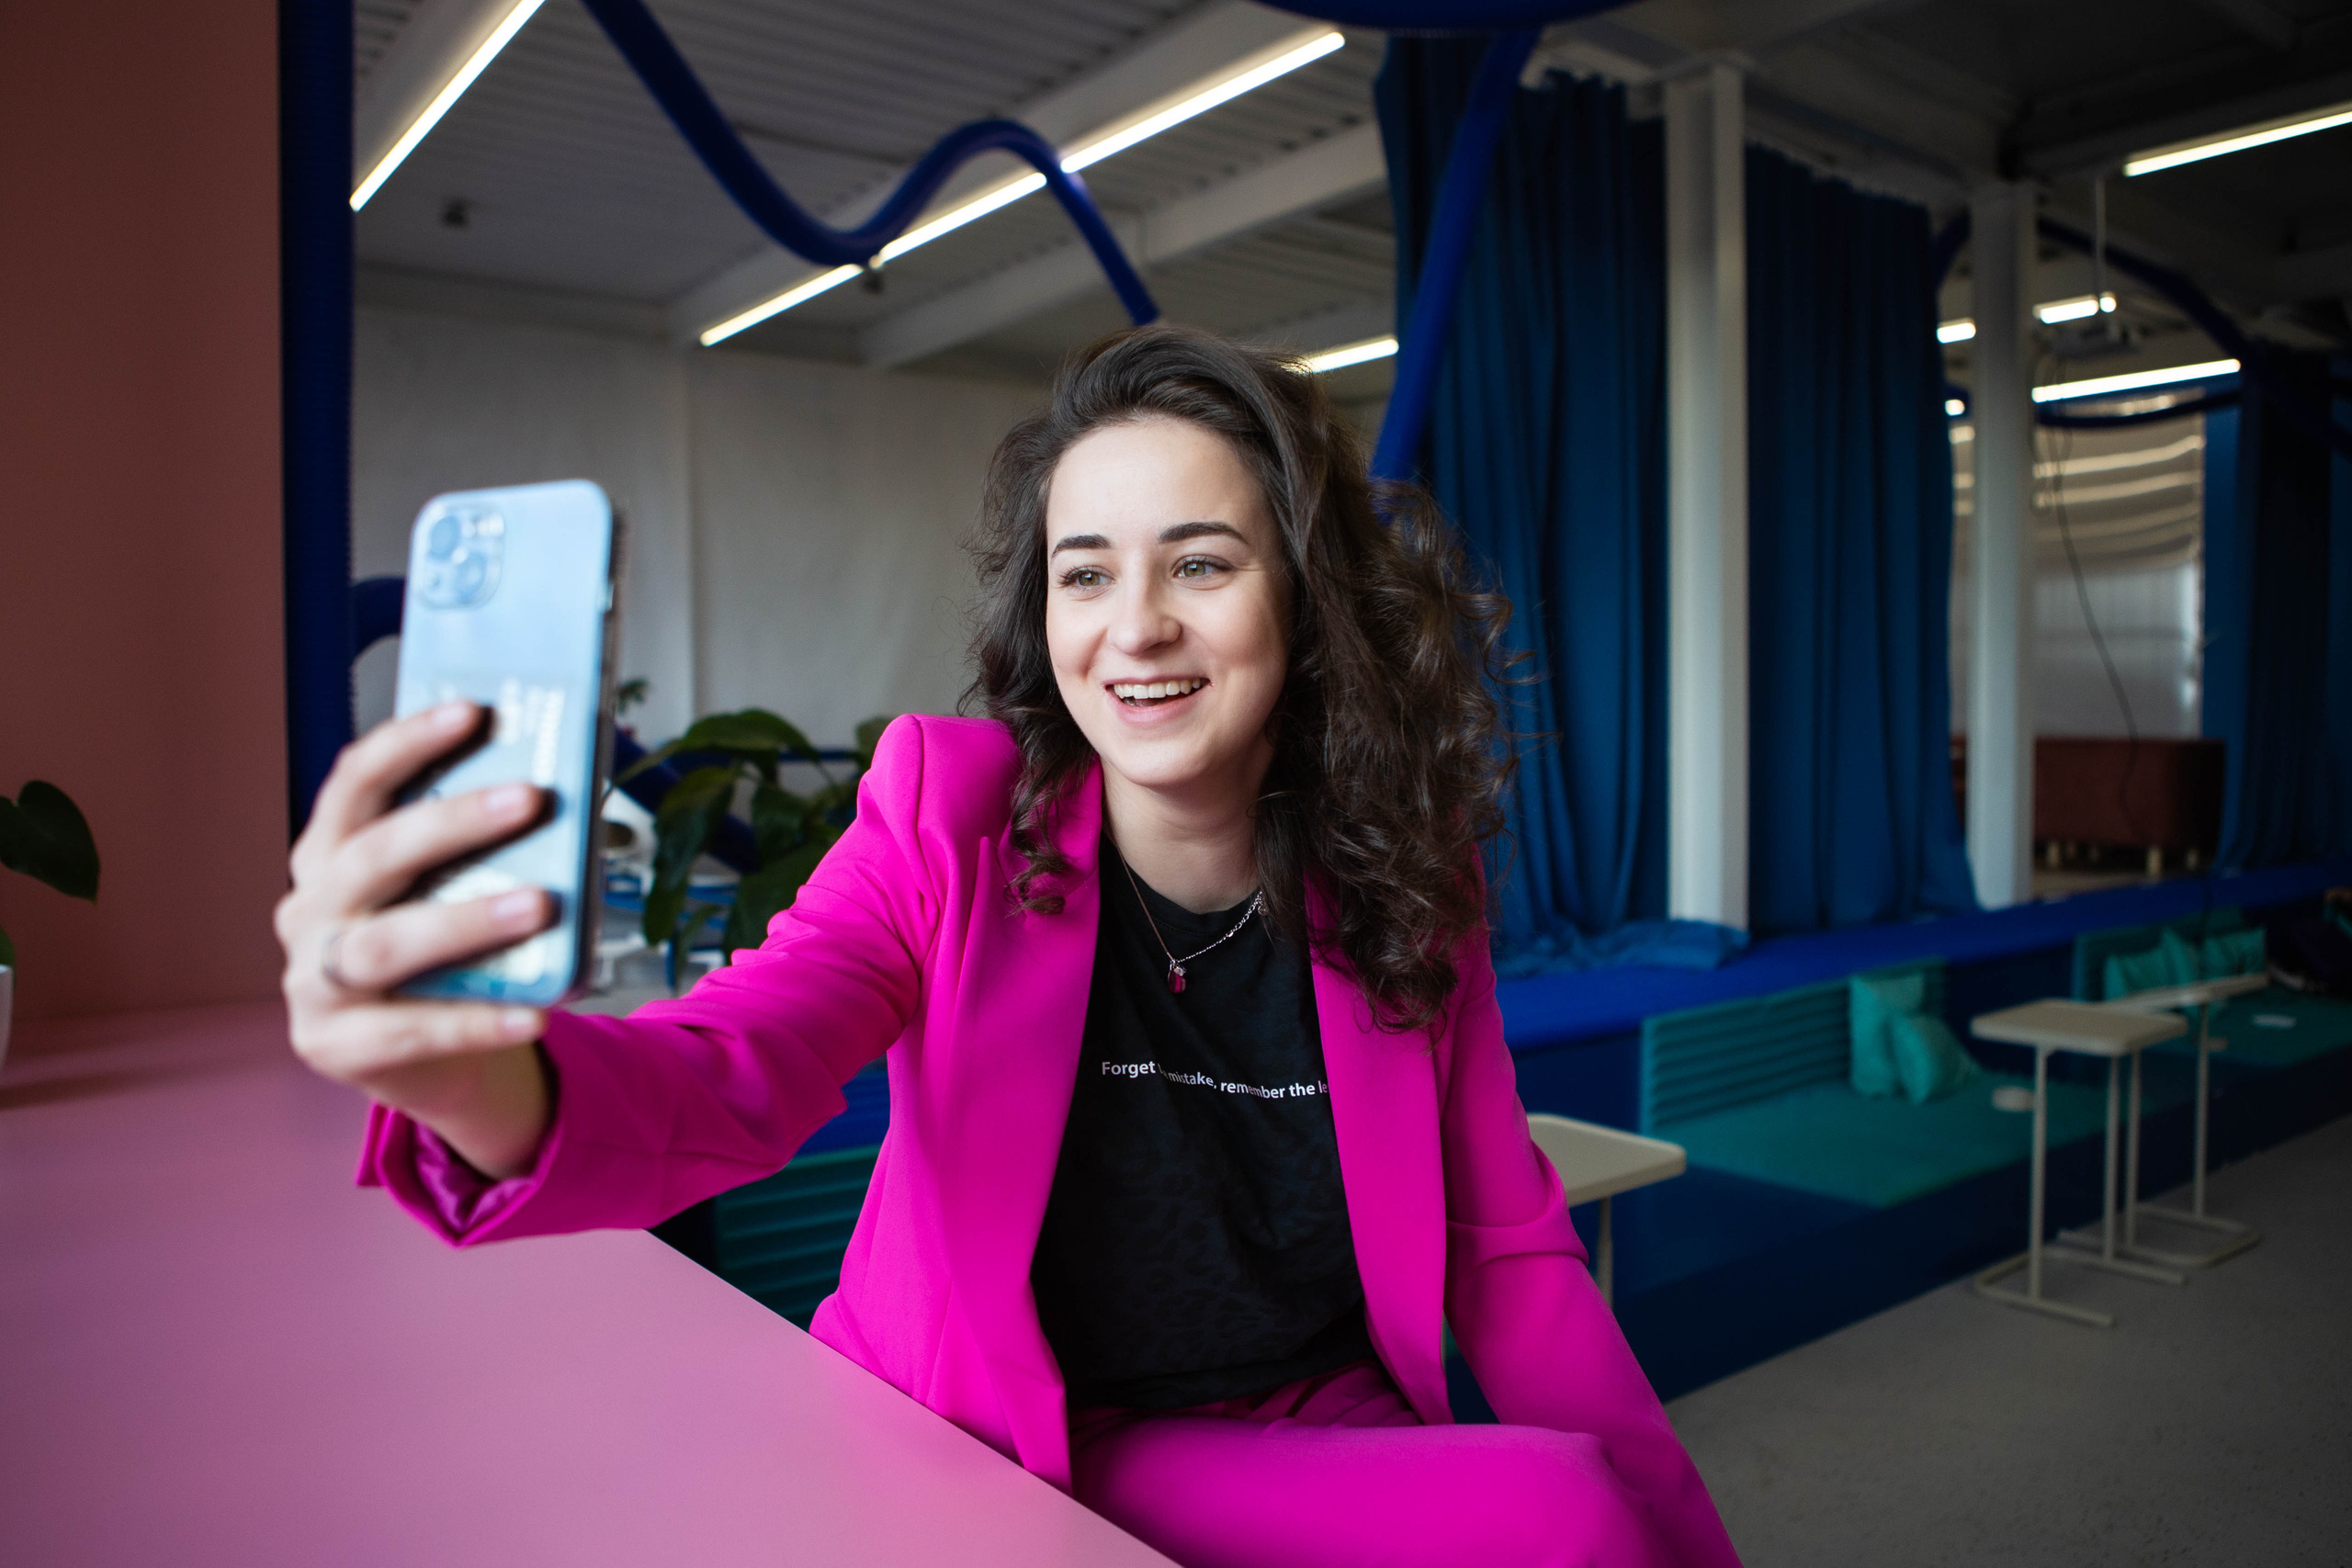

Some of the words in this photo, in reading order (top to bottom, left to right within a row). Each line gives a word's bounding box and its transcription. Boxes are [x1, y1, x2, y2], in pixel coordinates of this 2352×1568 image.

[1102, 1061, 1156, 1077] Forget
[1168, 1071, 1217, 1089] mistake,
[1220, 1080, 1285, 1099] remember
[1288, 1082, 1316, 1097] the
[1317, 1080, 1329, 1094] le
